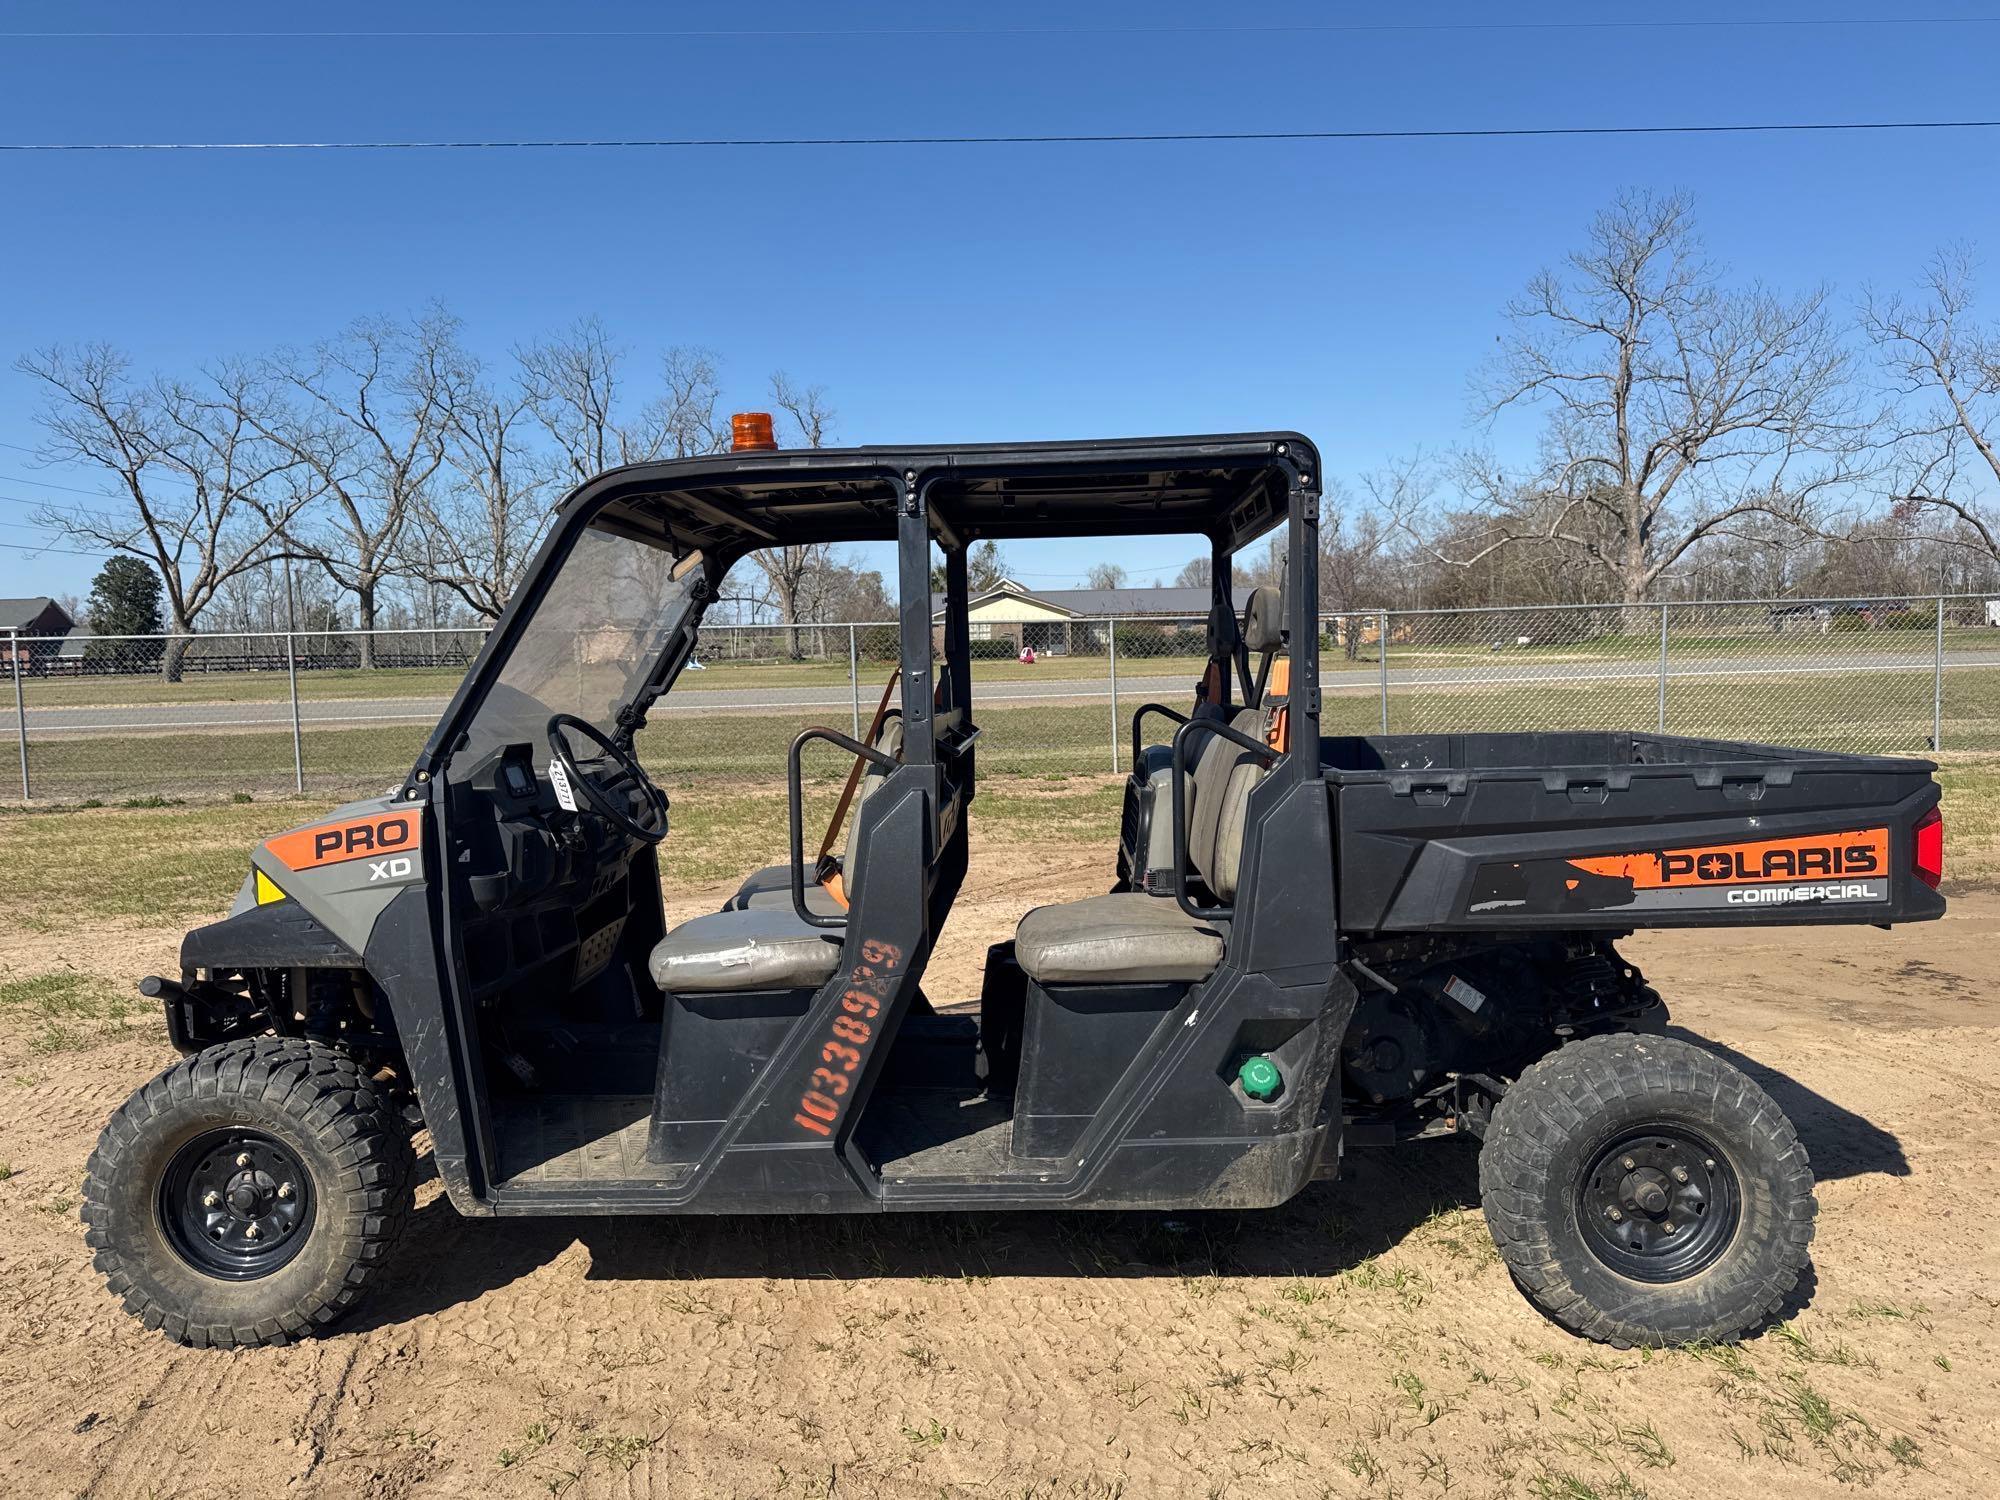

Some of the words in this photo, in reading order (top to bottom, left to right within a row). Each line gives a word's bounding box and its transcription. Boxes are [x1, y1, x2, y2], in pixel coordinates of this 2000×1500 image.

[555, 771, 571, 804] 213771
[315, 818, 409, 860] PRO
[368, 857, 411, 881] XD
[1661, 844, 1878, 883] POLARIS
[1727, 884, 1878, 904] COMMERCIAL
